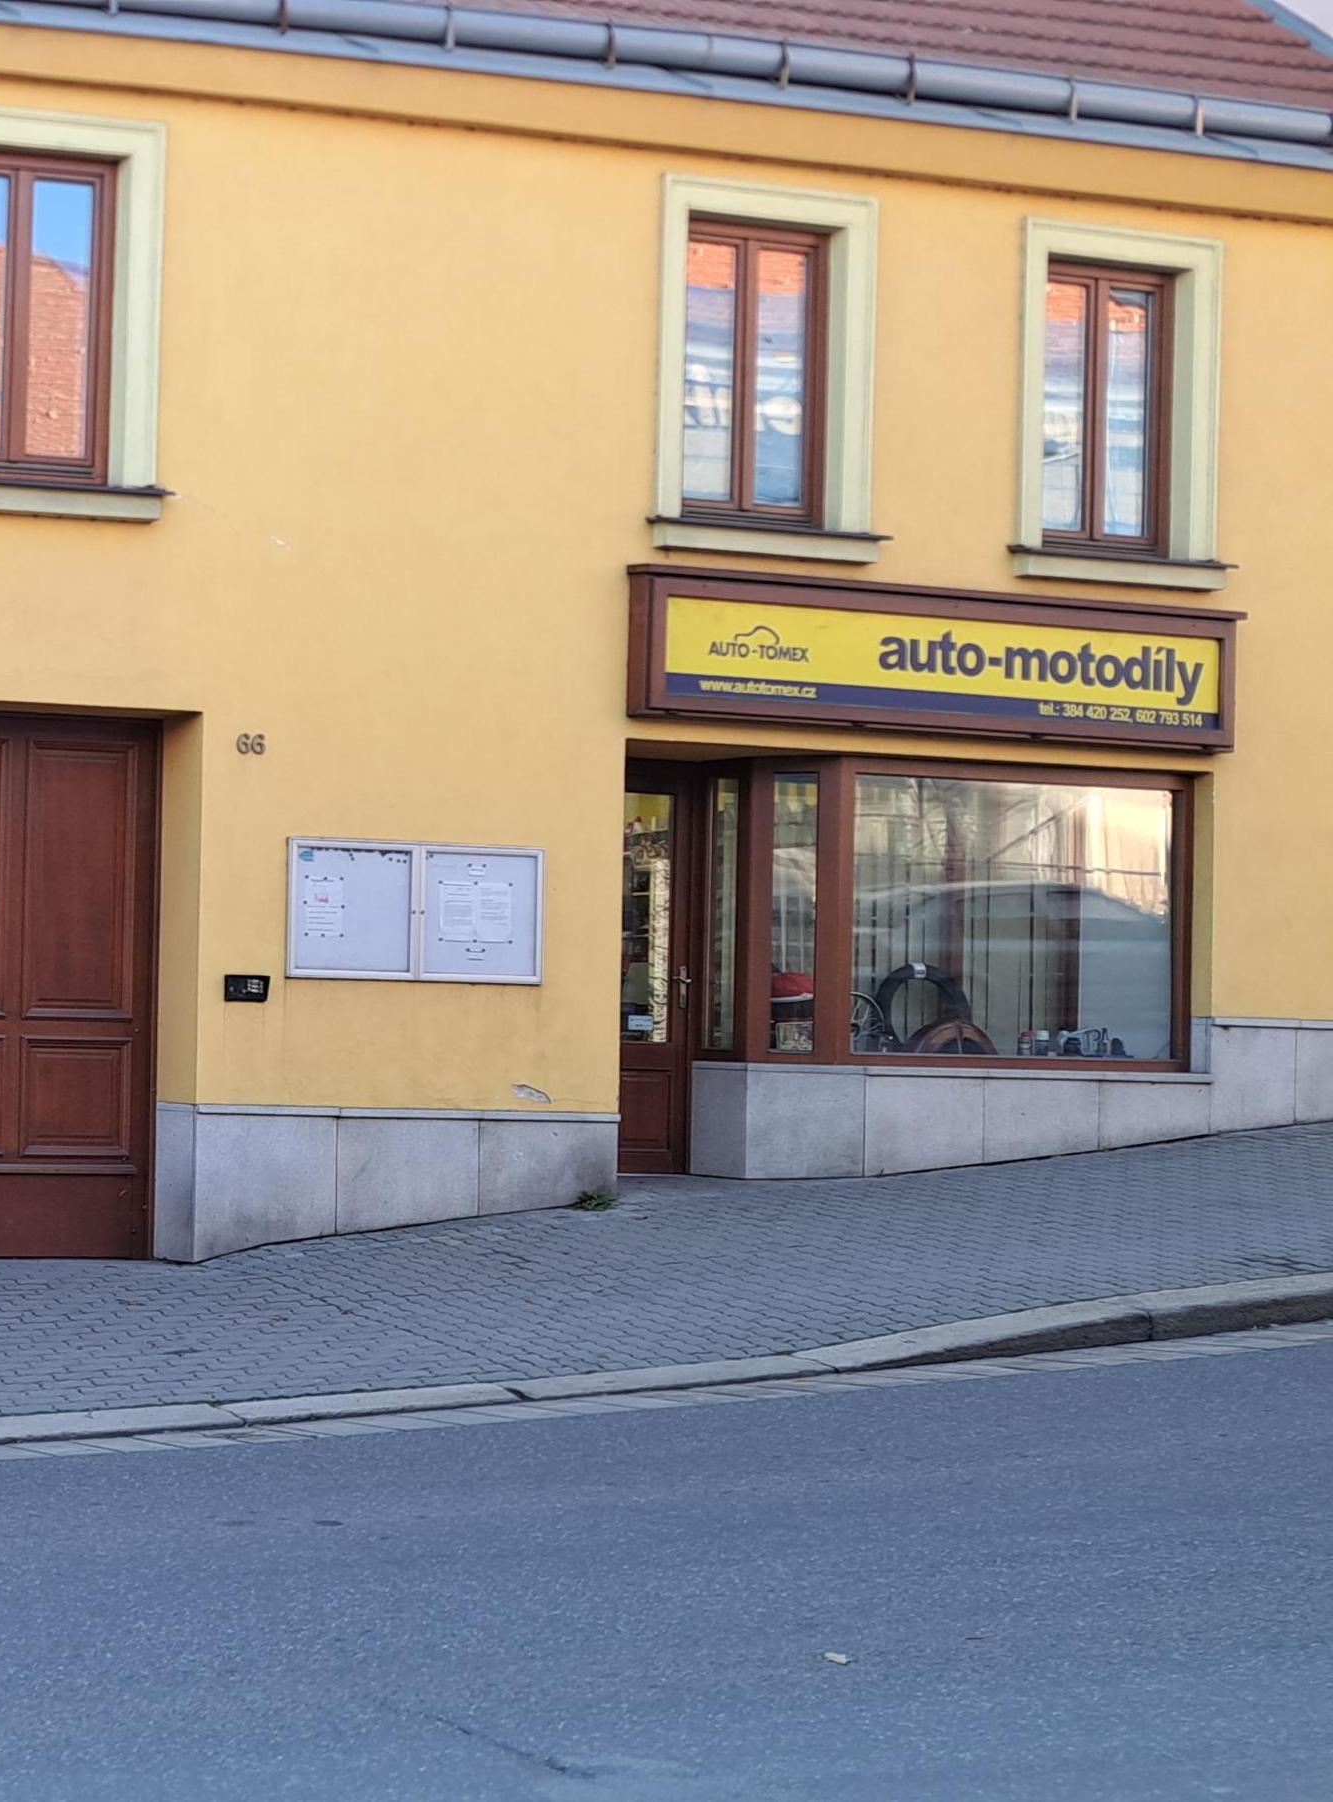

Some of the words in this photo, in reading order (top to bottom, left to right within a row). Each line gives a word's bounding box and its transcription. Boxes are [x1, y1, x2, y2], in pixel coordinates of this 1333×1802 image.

[708, 640, 809, 663] AUTO-TOMEX
[878, 630, 1204, 706] auto-motodíly
[699, 679, 817, 699] www.autotomex.cz
[1038, 702, 1059, 717] tel.:
[1062, 703, 1083, 718] 384
[1086, 705, 1107, 720] 420
[1109, 707, 1132, 723] 252,
[1136, 709, 1156, 723] 602
[1159, 711, 1180, 726] 793
[1182, 712, 1203, 728] 514
[236, 733, 266, 755] 66
